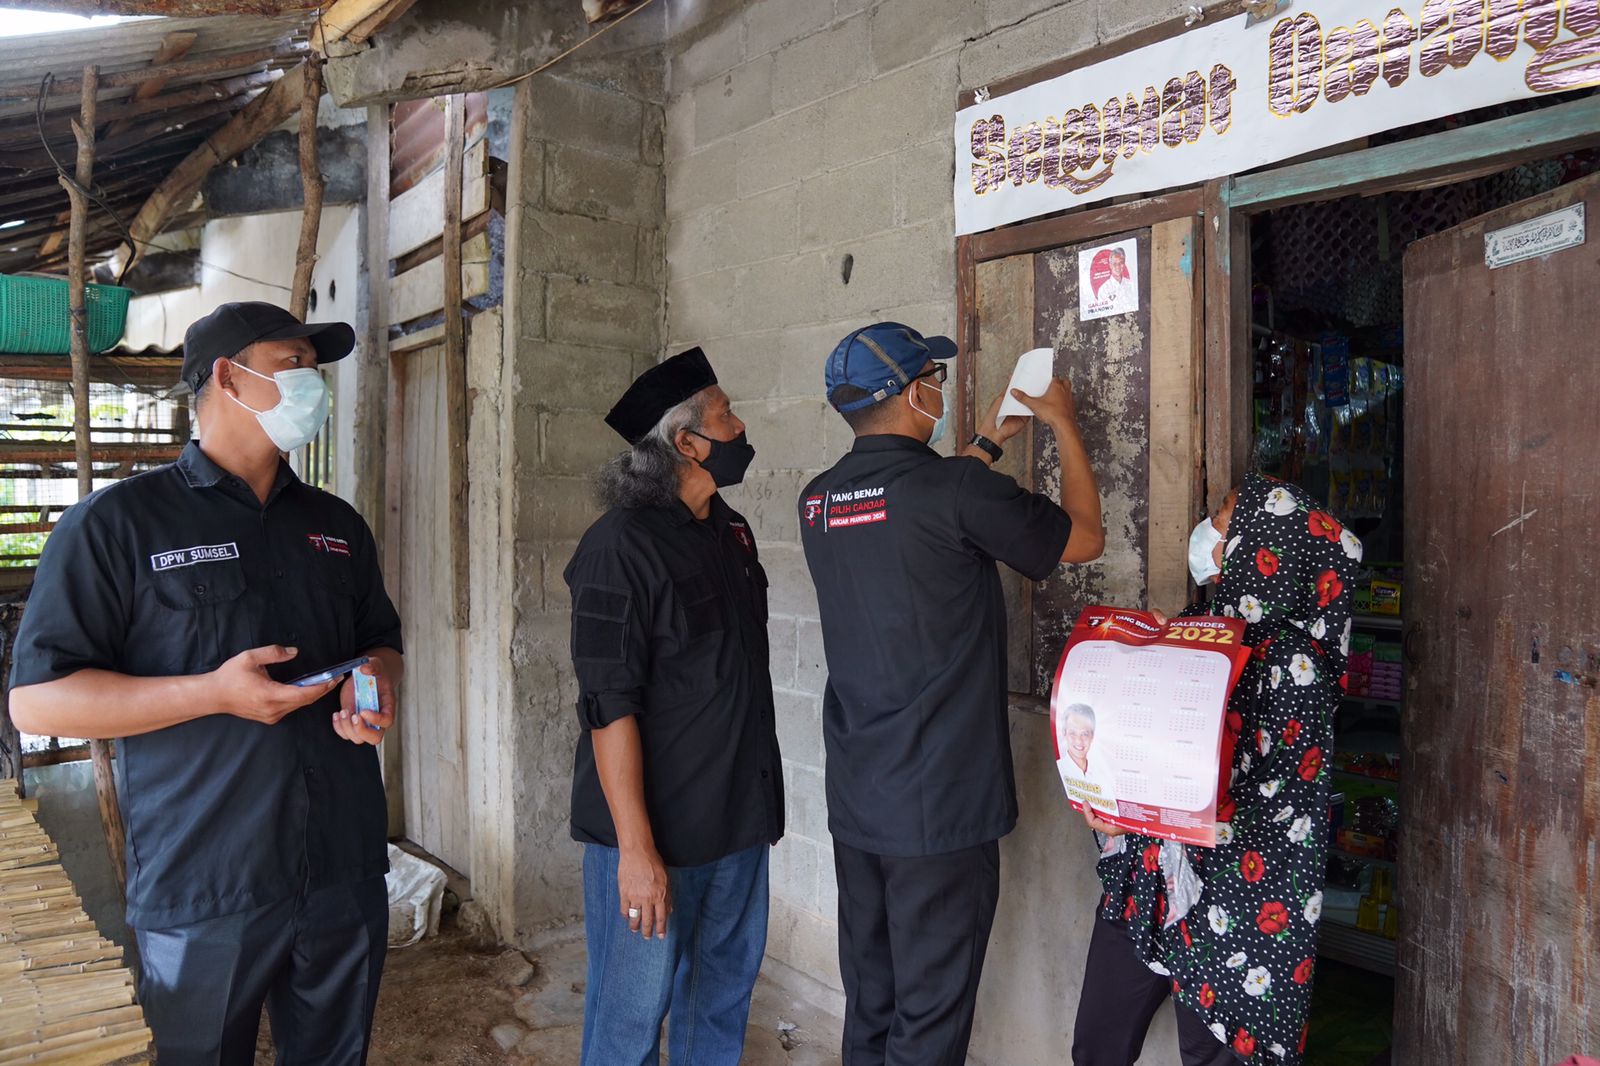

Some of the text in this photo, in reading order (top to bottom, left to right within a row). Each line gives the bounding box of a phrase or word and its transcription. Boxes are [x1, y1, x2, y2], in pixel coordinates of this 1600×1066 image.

[831, 487, 885, 503] YANG BENAR
[830, 499, 885, 515] PILIH GANJAR
[160, 547, 232, 567] DPW SUMSEL
[1115, 615, 1135, 624] YANG
[1169, 621, 1226, 629] KALENDER
[1165, 627, 1235, 645] 2022
